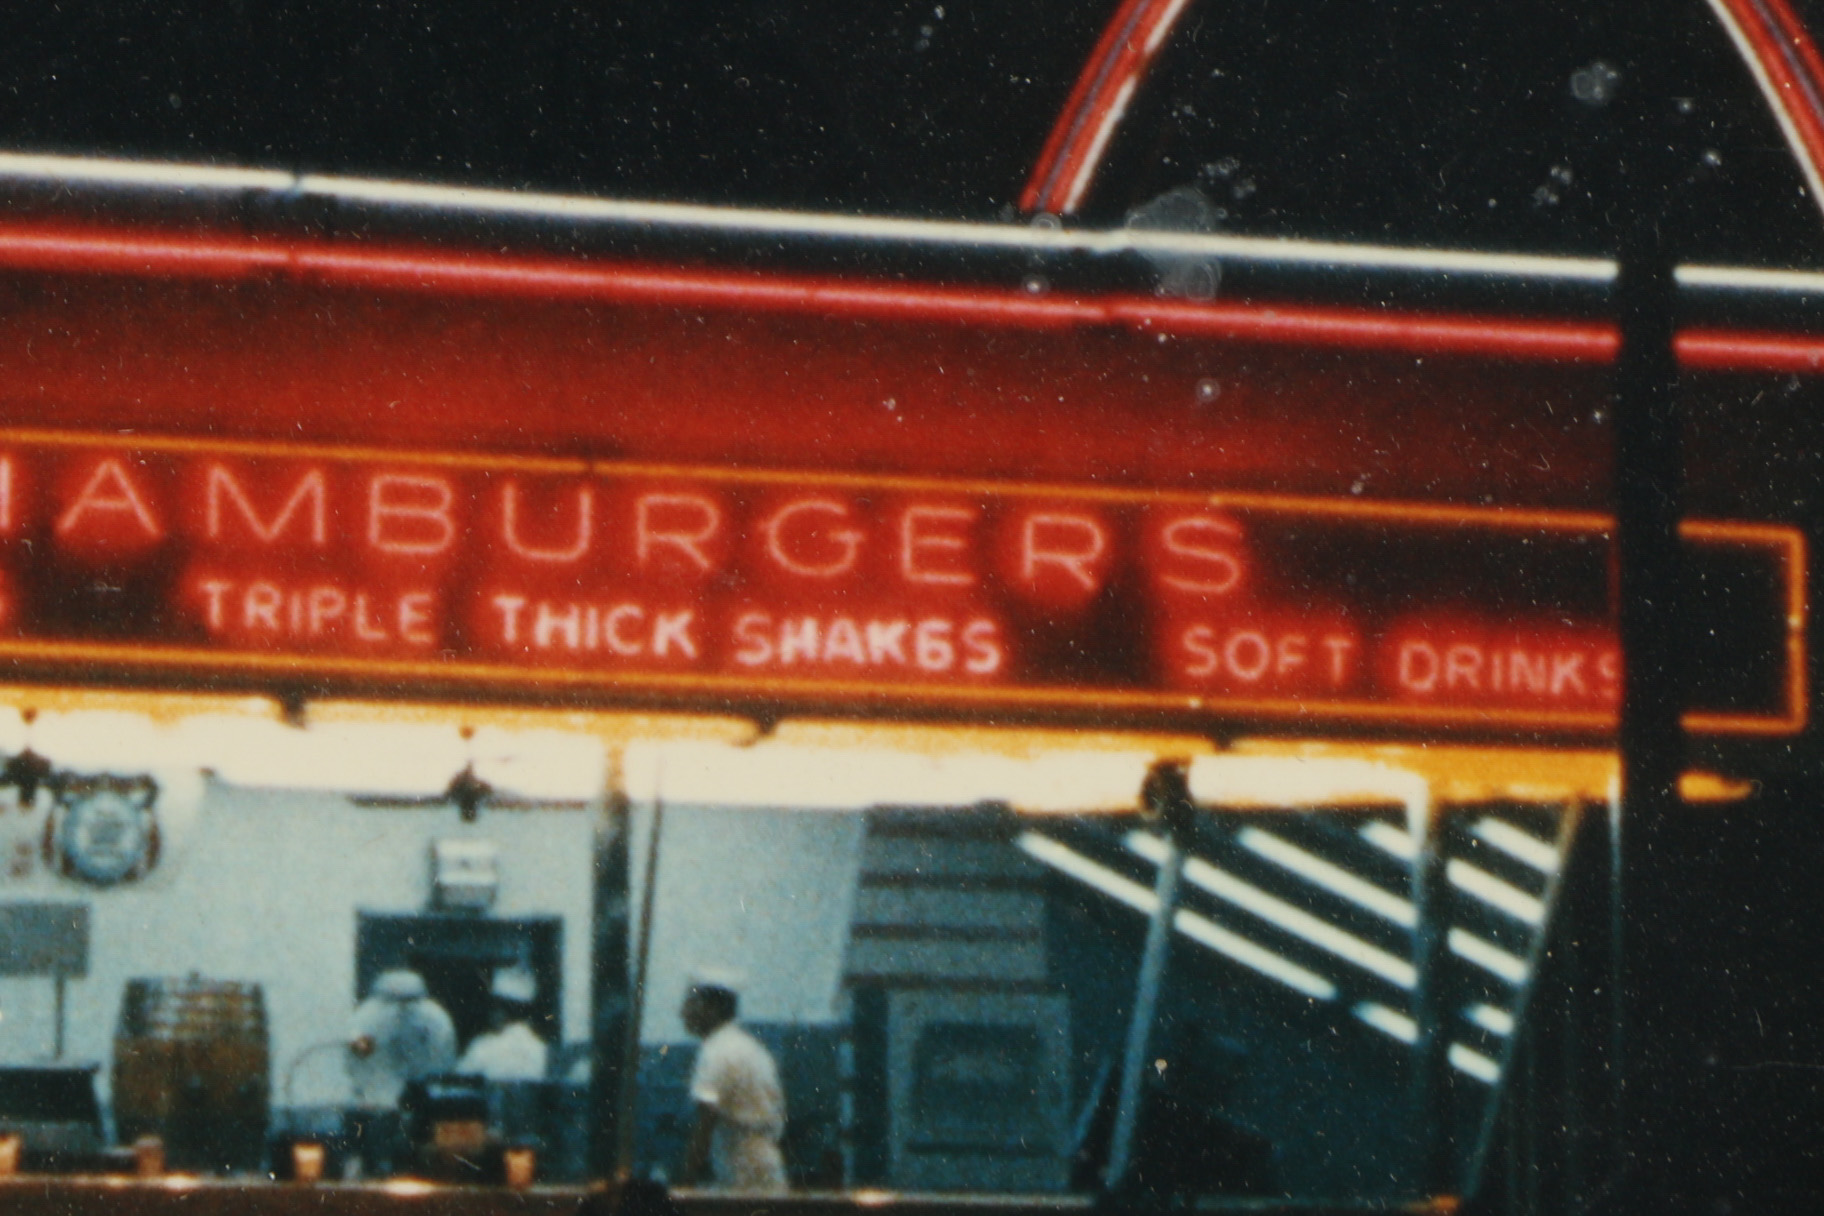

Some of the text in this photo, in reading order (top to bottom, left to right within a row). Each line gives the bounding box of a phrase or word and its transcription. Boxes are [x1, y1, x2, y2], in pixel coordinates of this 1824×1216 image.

[197, 580, 439, 646] TRIPLE
[492, 593, 700, 660] THICK
[1182, 625, 1355, 683] SOFT
